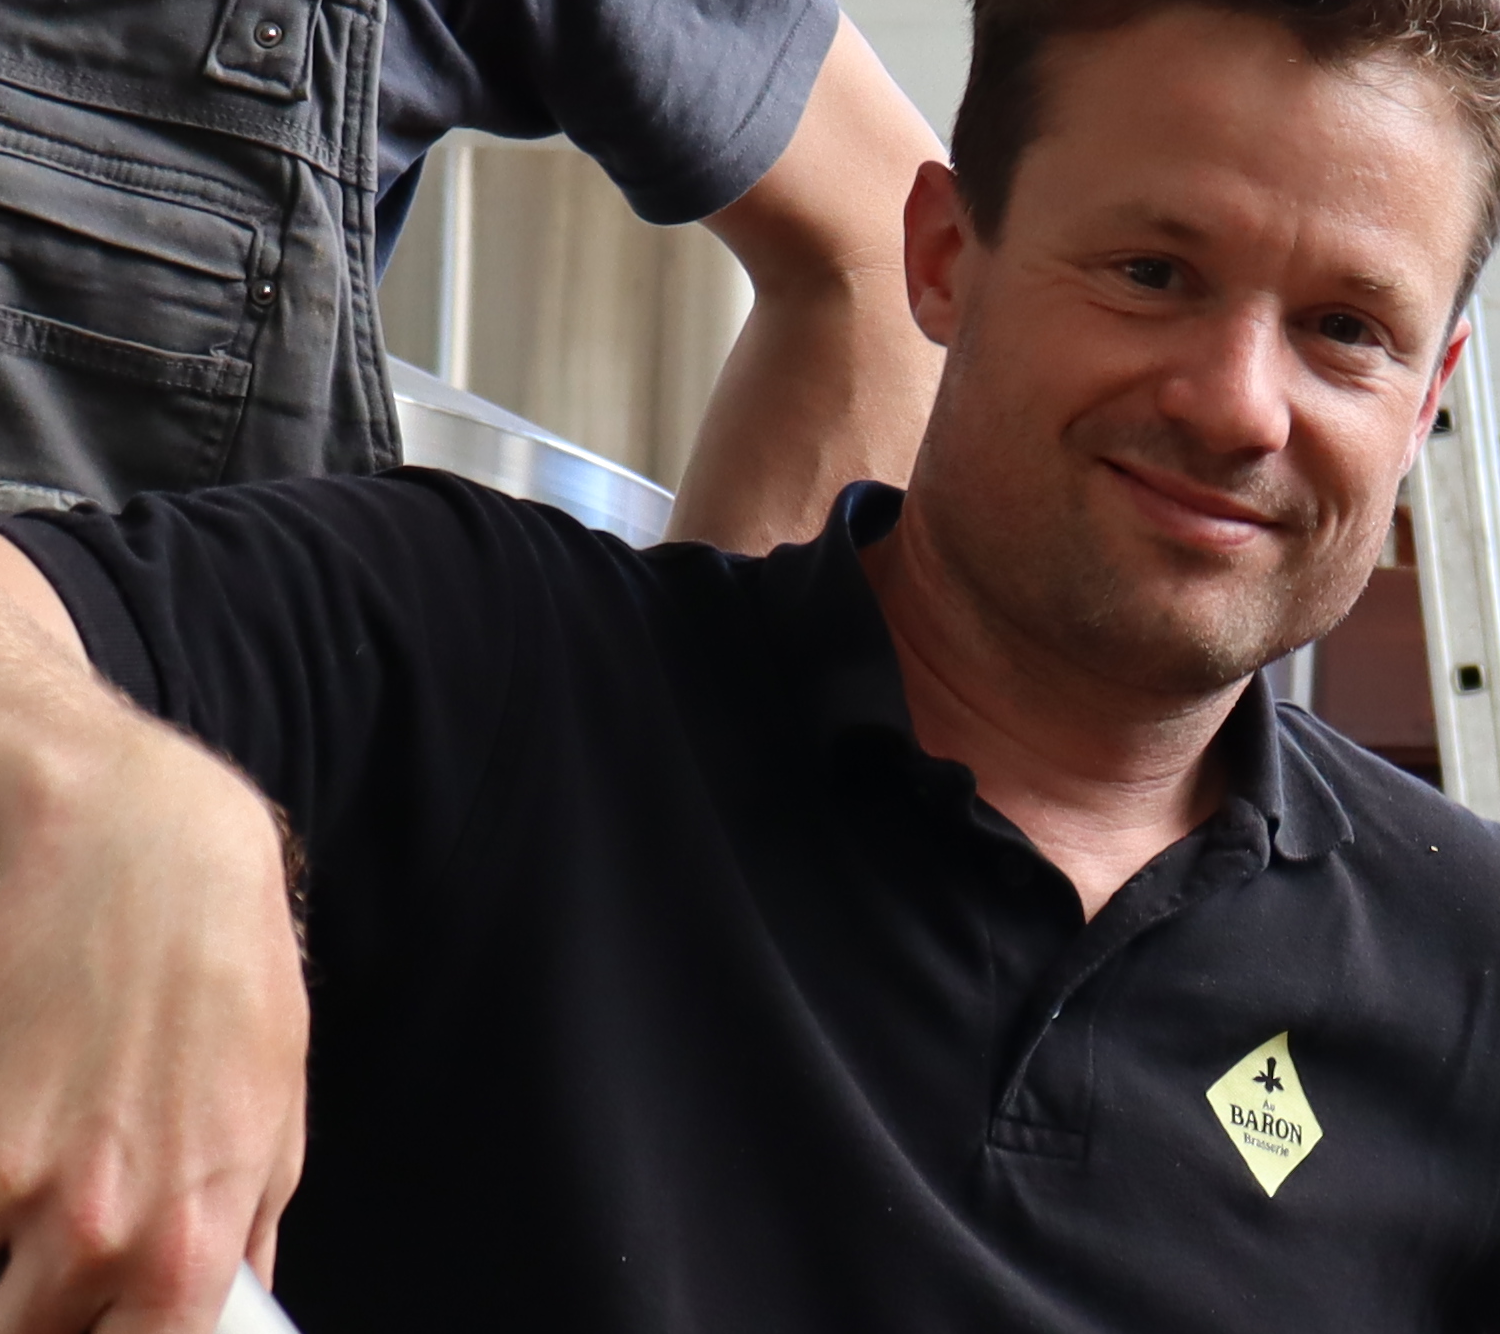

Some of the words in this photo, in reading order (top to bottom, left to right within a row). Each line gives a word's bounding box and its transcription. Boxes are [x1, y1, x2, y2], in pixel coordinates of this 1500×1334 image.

[1263, 1099, 1275, 1112] Au
[1230, 1104, 1302, 1146] BARON
[1243, 1132, 1290, 1157] Brasserie
